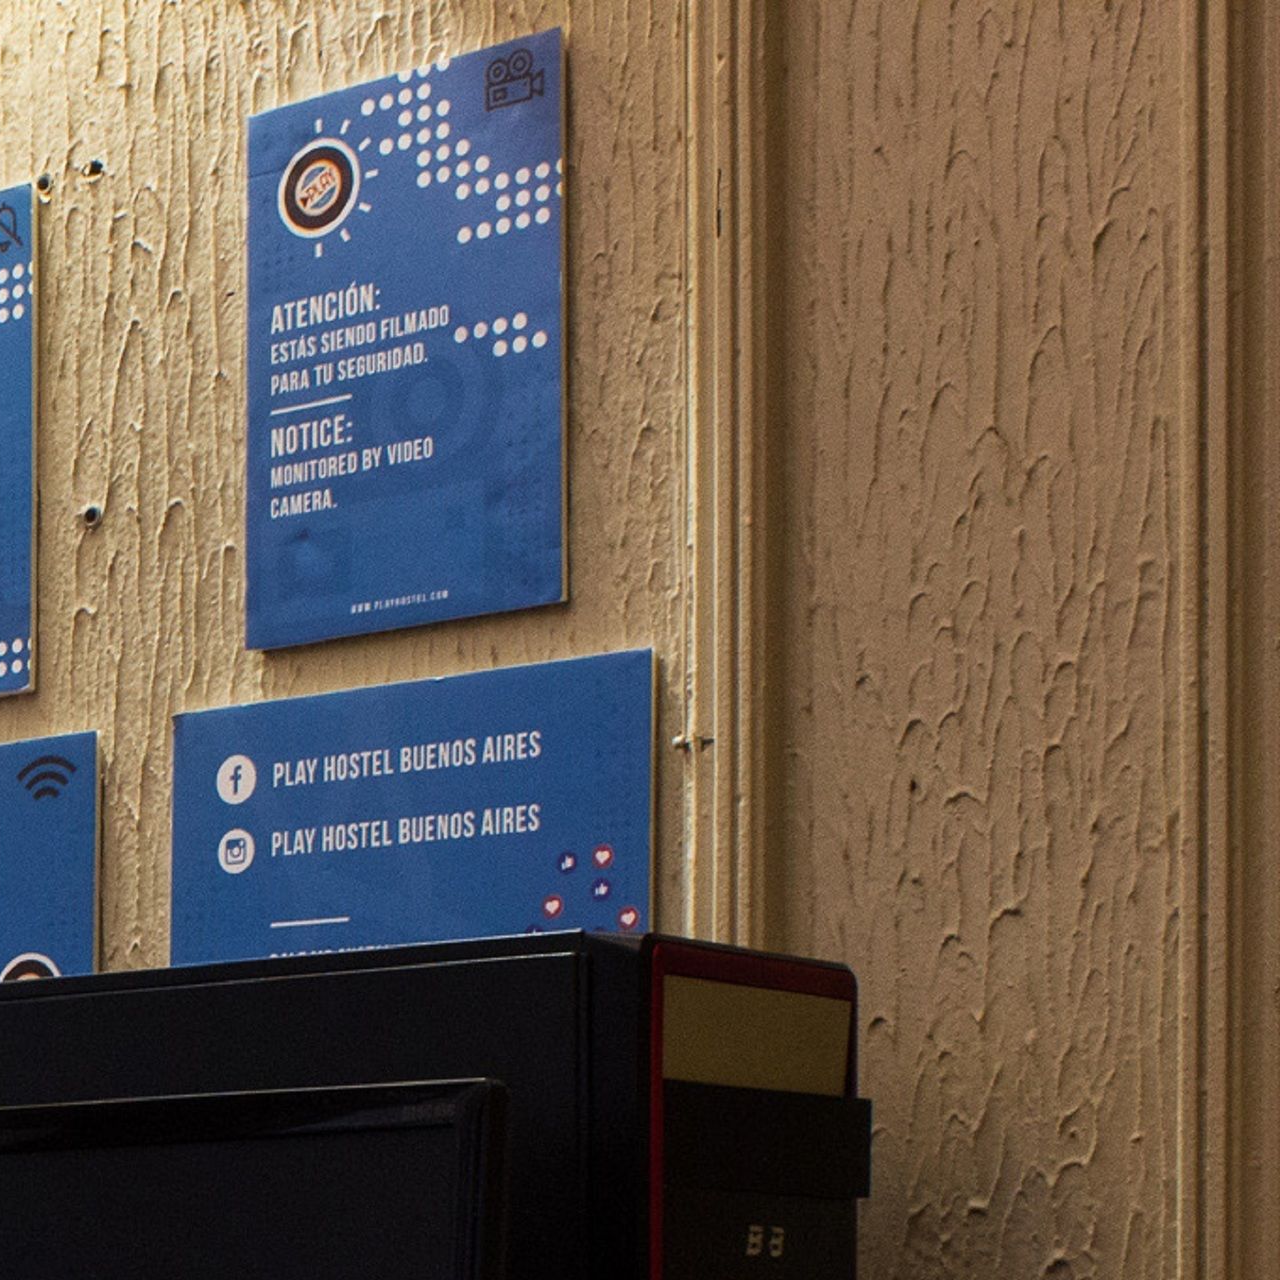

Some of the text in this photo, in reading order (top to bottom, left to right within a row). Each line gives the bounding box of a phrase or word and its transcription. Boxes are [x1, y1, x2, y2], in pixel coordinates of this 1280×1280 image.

[271, 281, 381, 334] ATENCIÓN:
[271, 305, 450, 365] ESTÁS SIENDO FILMADO
[271, 342, 428, 396] PARA TU SEGURIDAD.
[271, 415, 353, 457] NOTICE:
[271, 437, 433, 488] MONITORED BY VIDEO
[271, 489, 338, 519] CAMERA.
[272, 730, 541, 788] PLAY HOSTEL BUENOS AIRES
[271, 803, 540, 857] PLAY HOSTEL BUENOS AIRES
